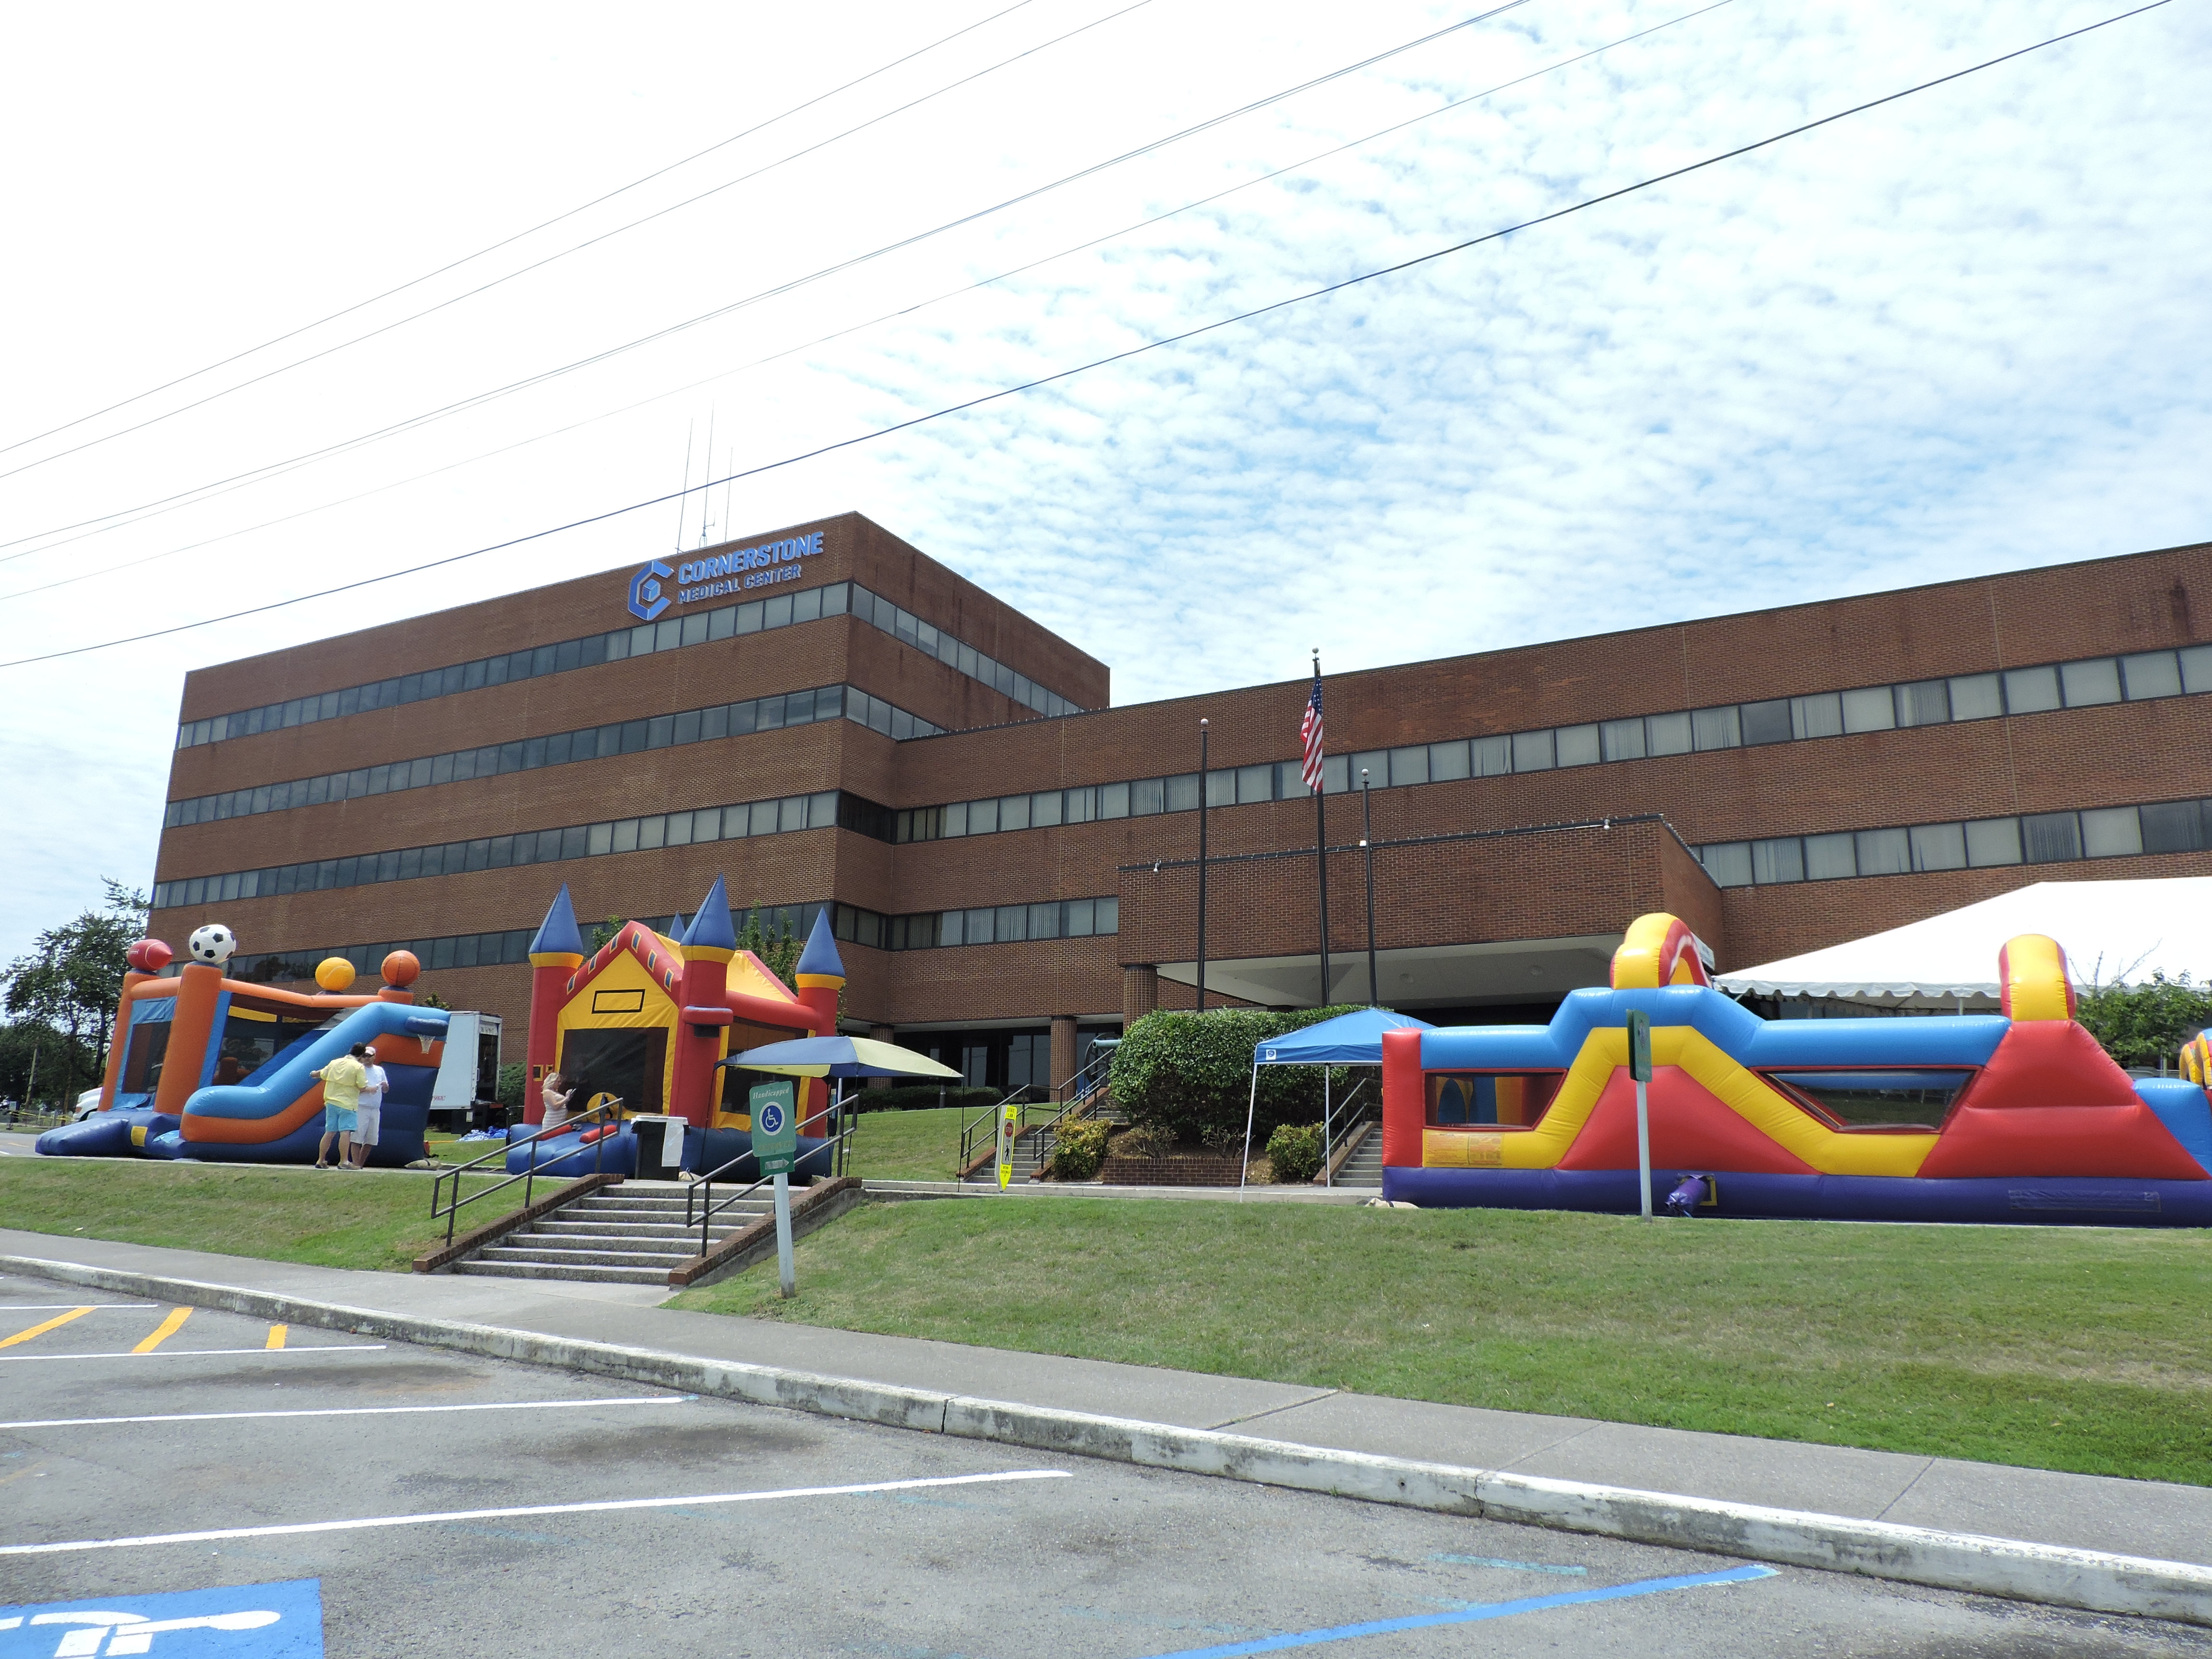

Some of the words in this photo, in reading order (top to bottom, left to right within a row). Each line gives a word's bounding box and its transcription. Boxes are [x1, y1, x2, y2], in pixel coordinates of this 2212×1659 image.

[677, 531, 824, 585] CORNERSTONE
[678, 578, 740, 604] MEDICAL
[744, 564, 802, 589] CENTER
[753, 1087, 789, 1099] Handicapped
